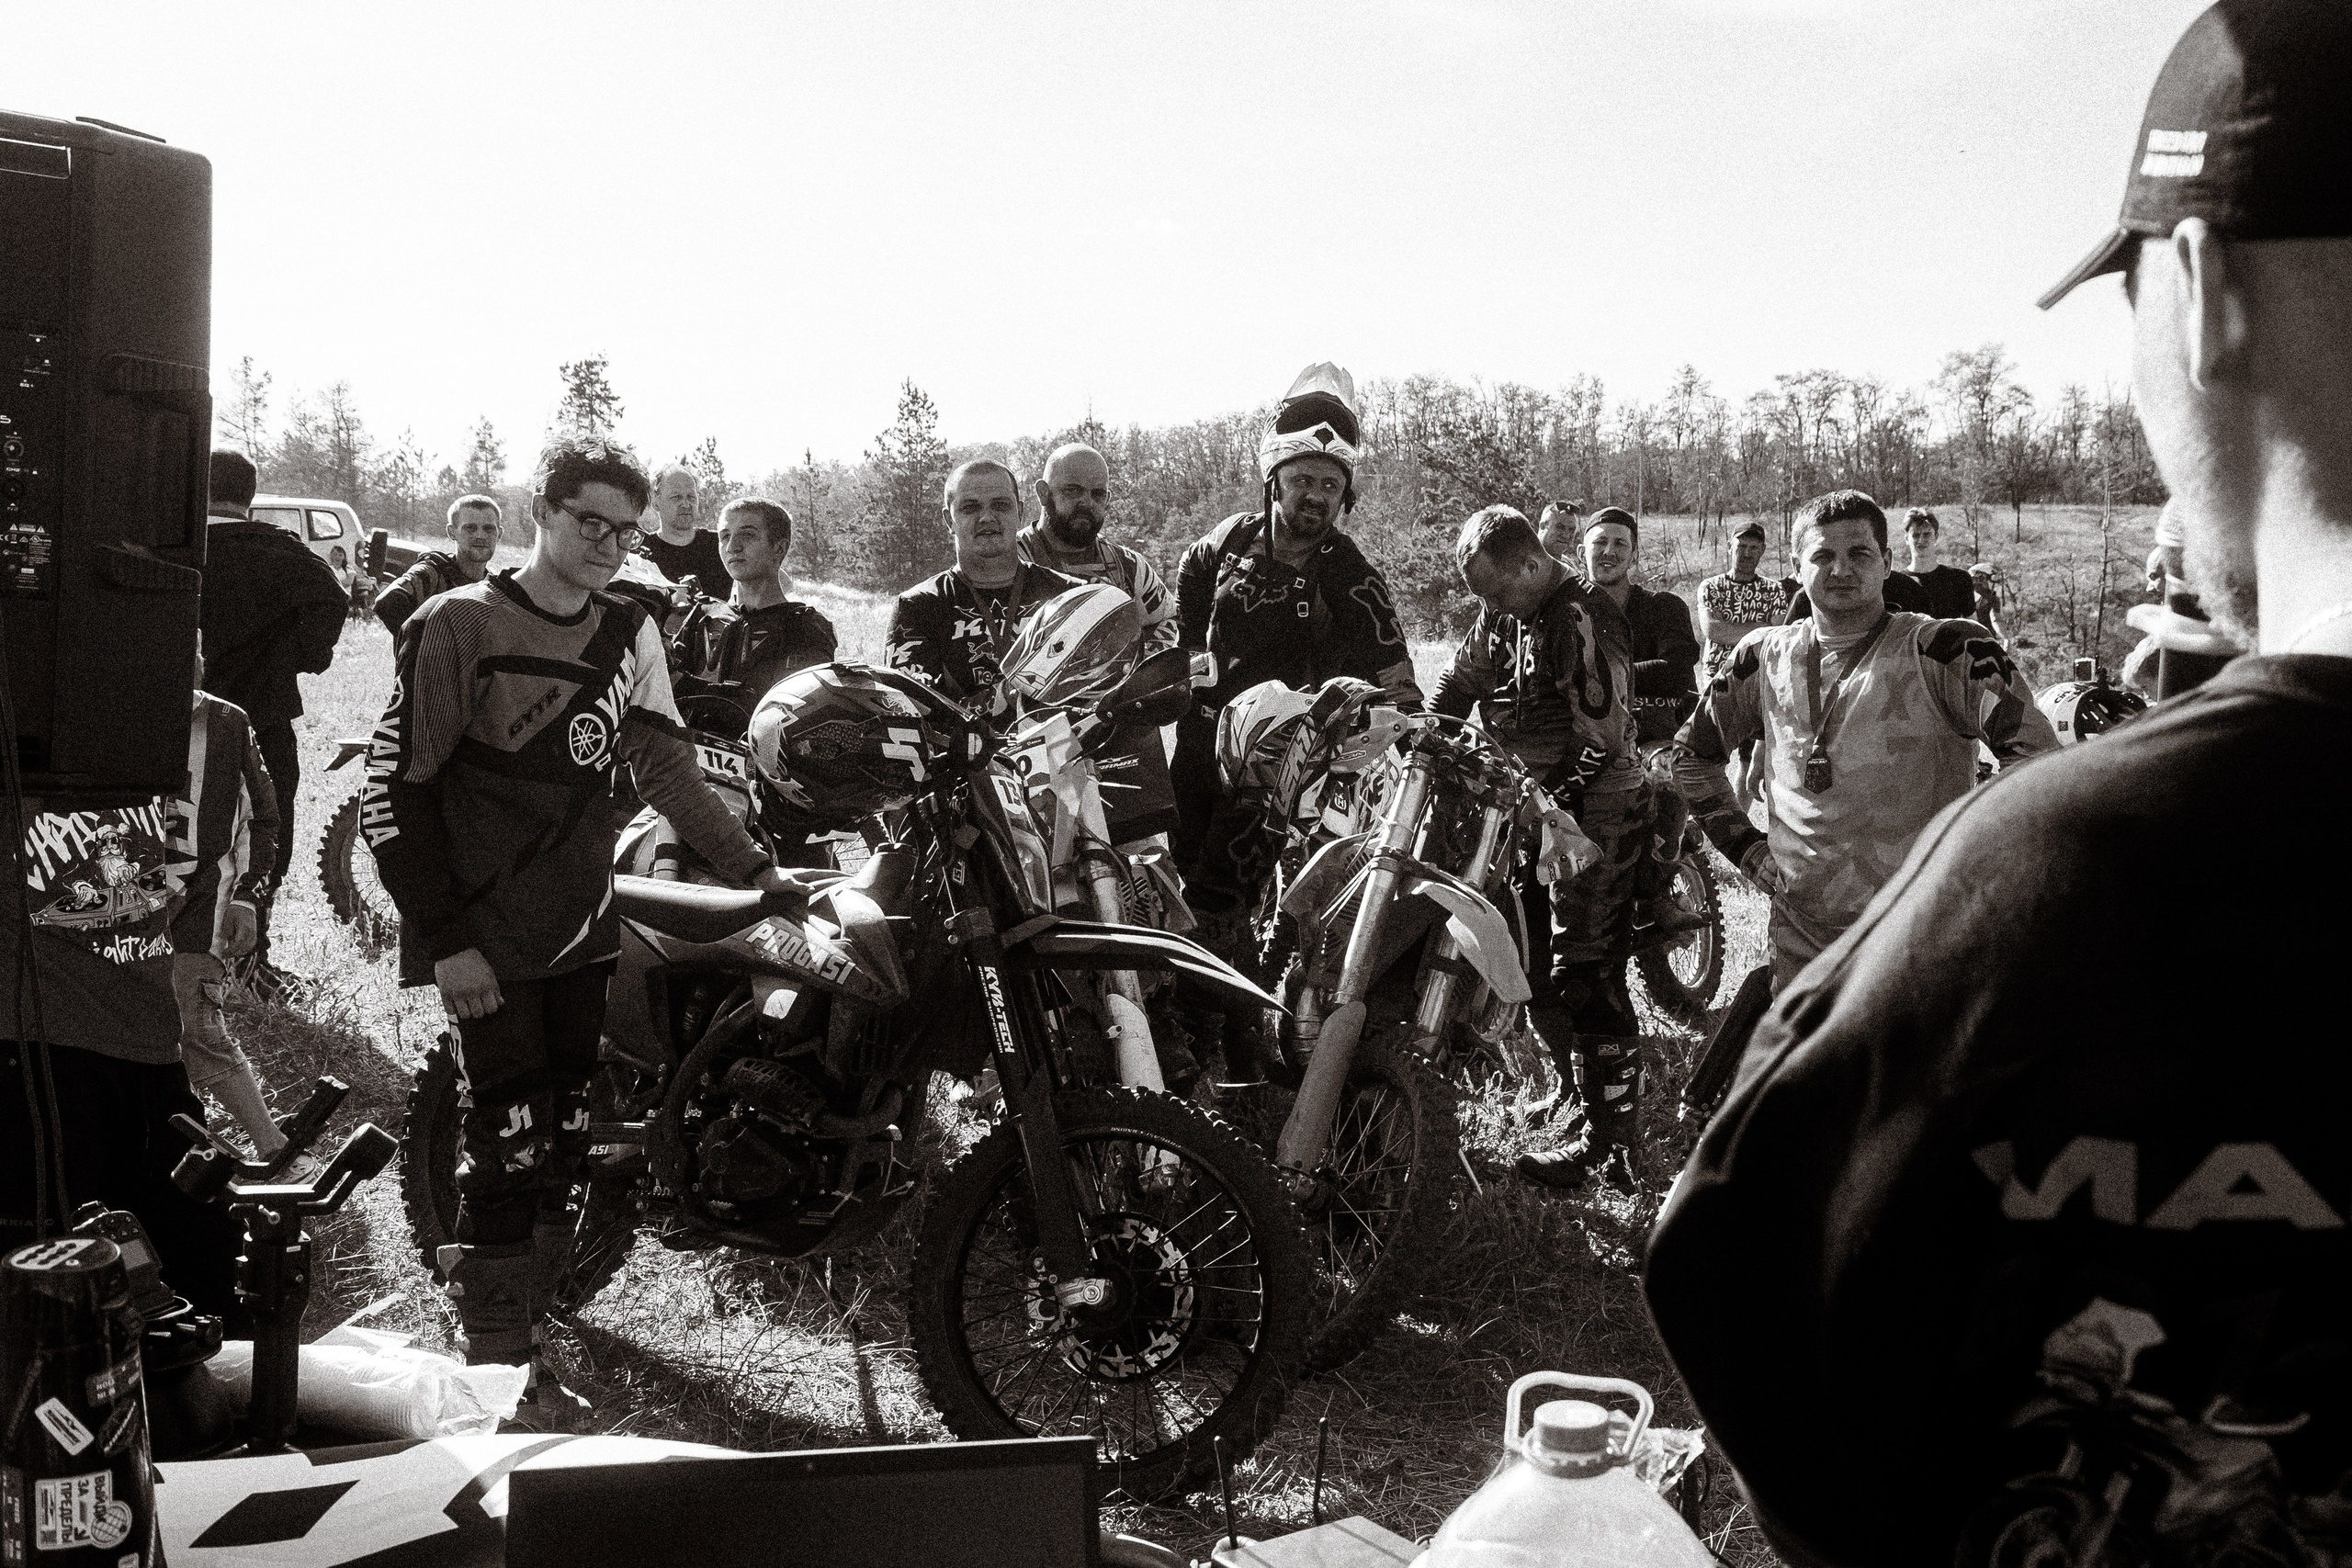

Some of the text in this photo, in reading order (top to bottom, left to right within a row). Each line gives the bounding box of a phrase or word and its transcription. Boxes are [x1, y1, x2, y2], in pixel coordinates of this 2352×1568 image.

[362, 716, 401, 848] YAMAHA
[704, 749, 740, 775] 114
[745, 922, 856, 986] PROGASI
[983, 965, 1015, 1054] KYB-TECH
